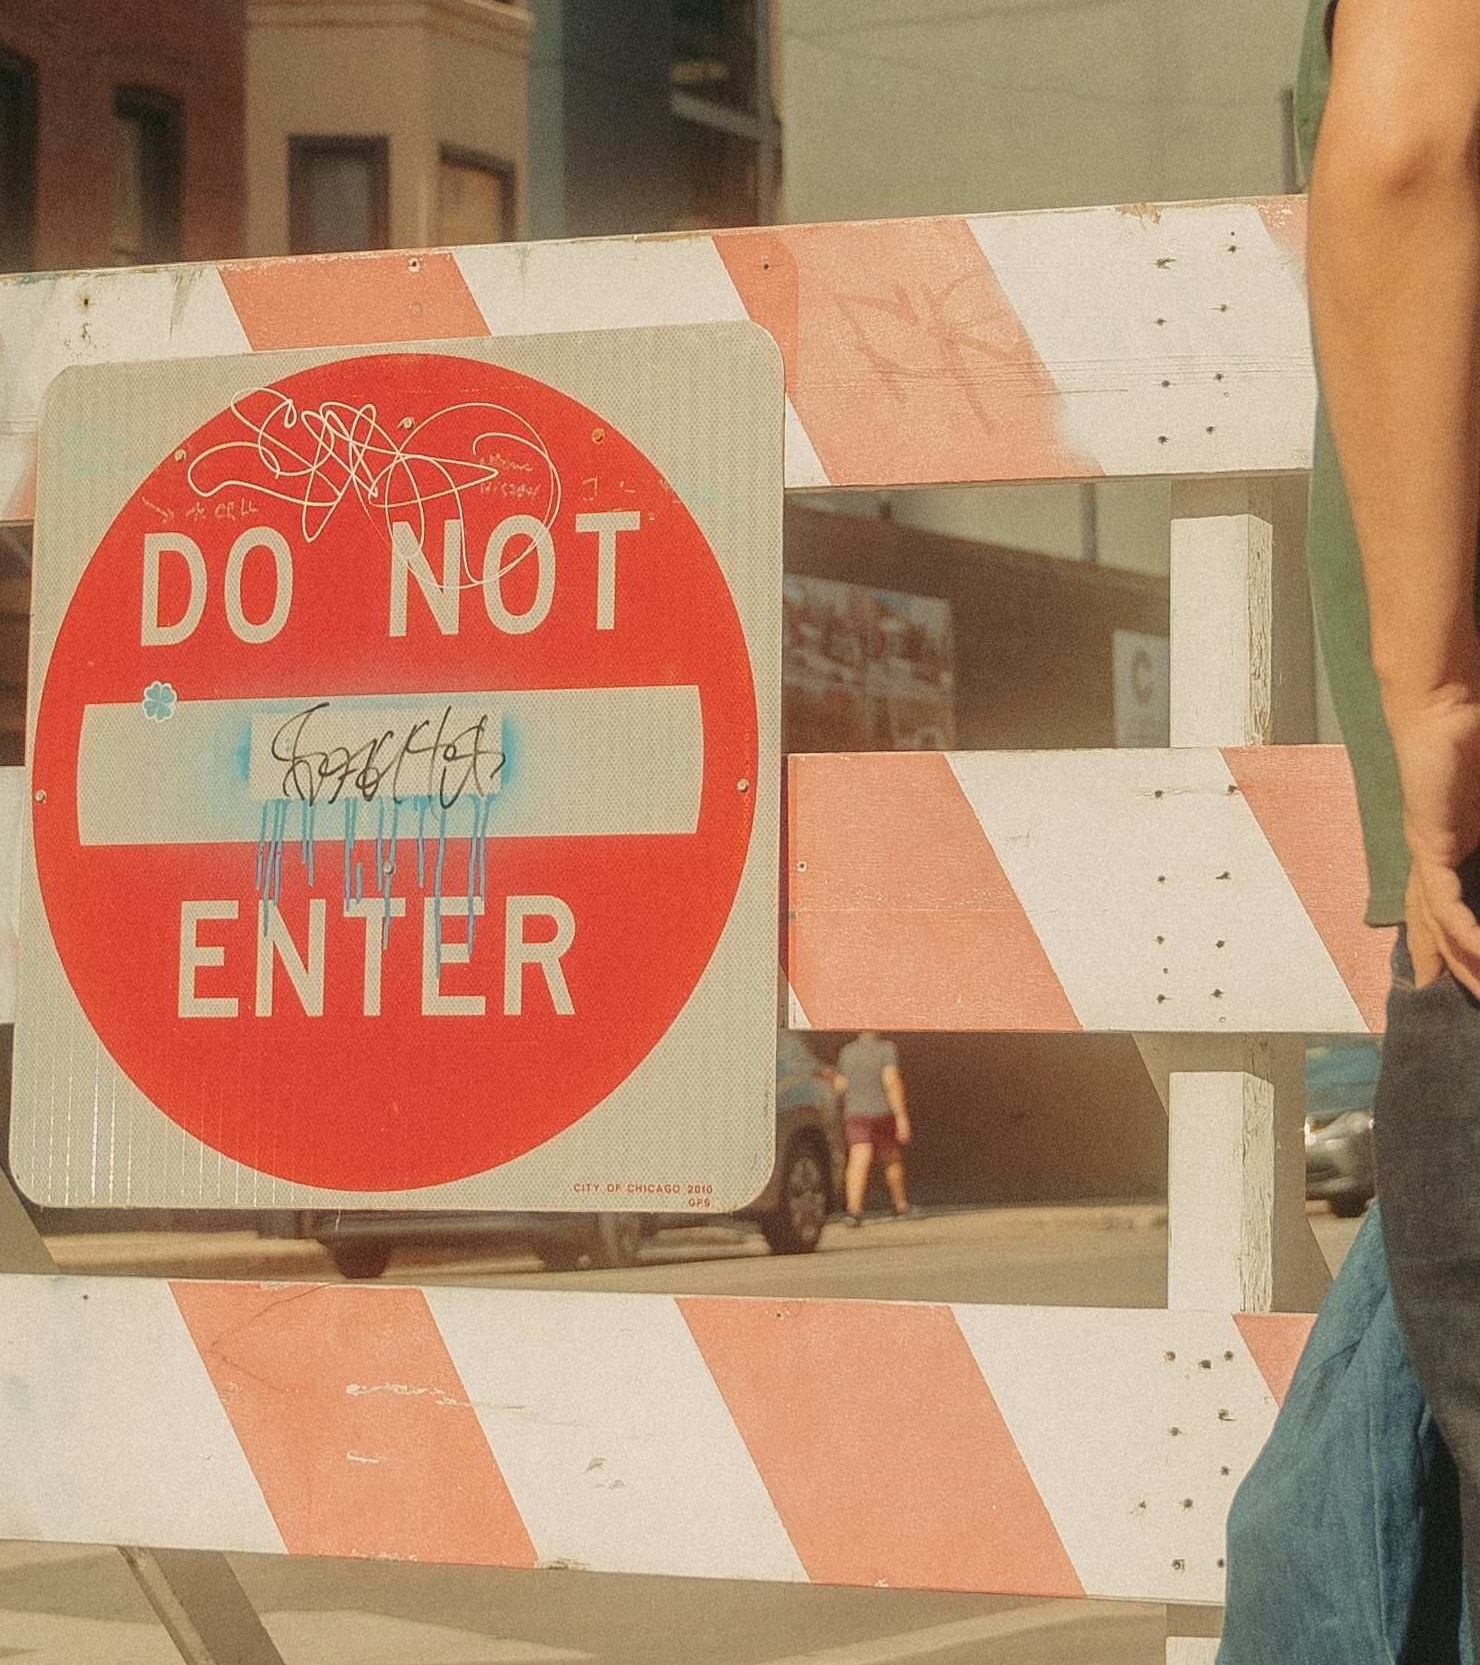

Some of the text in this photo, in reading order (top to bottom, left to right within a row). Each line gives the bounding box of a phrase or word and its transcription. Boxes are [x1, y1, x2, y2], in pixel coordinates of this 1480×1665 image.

[140, 510, 641, 647] DO NOT
[177, 894, 577, 1019] ENTER
[573, 1183, 713, 1195] CITY OF CHICAGO 2010
